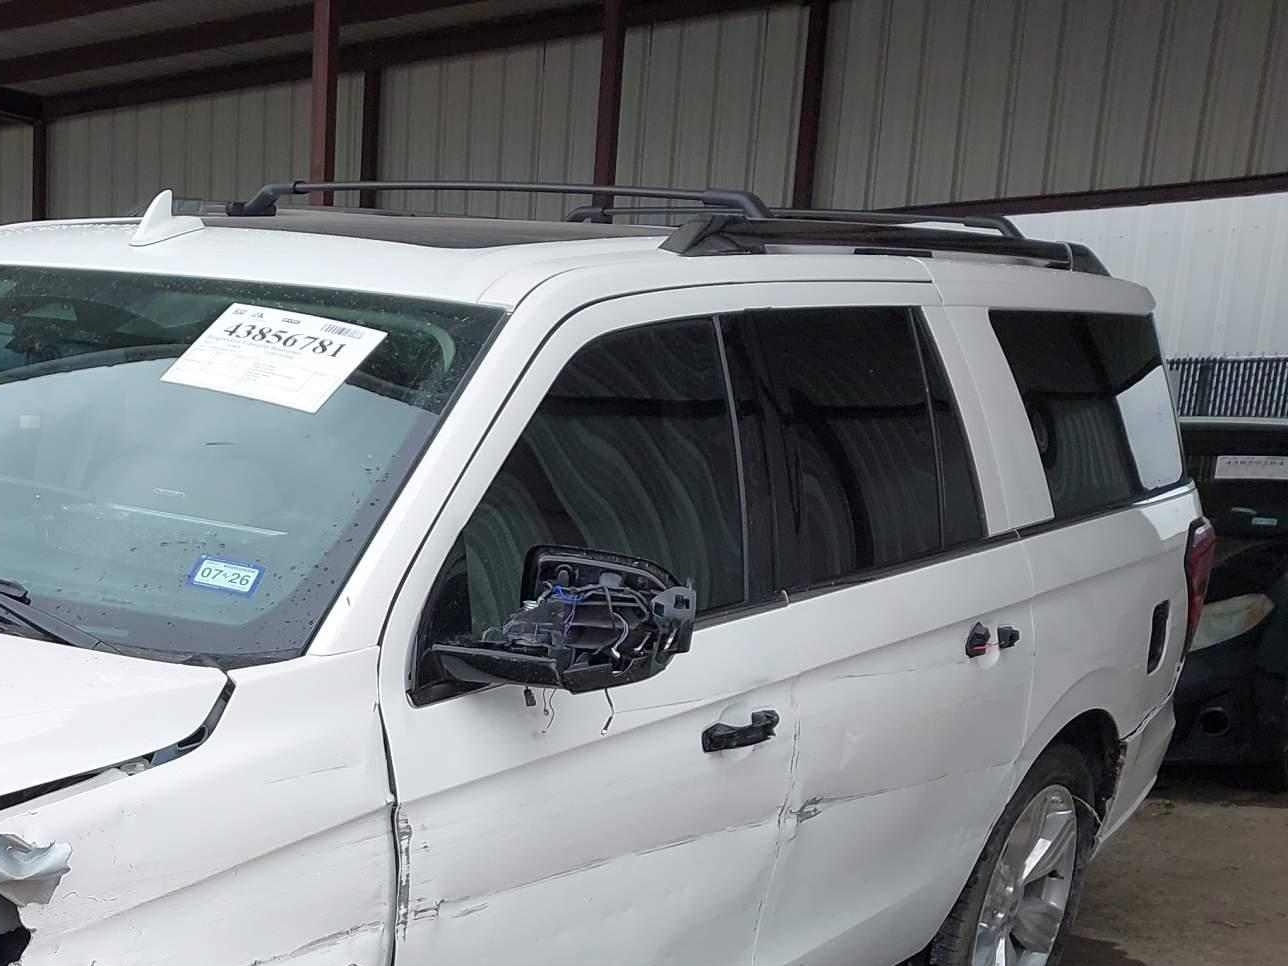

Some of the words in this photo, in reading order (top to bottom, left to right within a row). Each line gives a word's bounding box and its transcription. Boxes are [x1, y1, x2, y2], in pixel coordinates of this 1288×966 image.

[223, 322, 347, 358] 43856781
[200, 567, 224, 580] 07
[228, 572, 252, 586] 26
